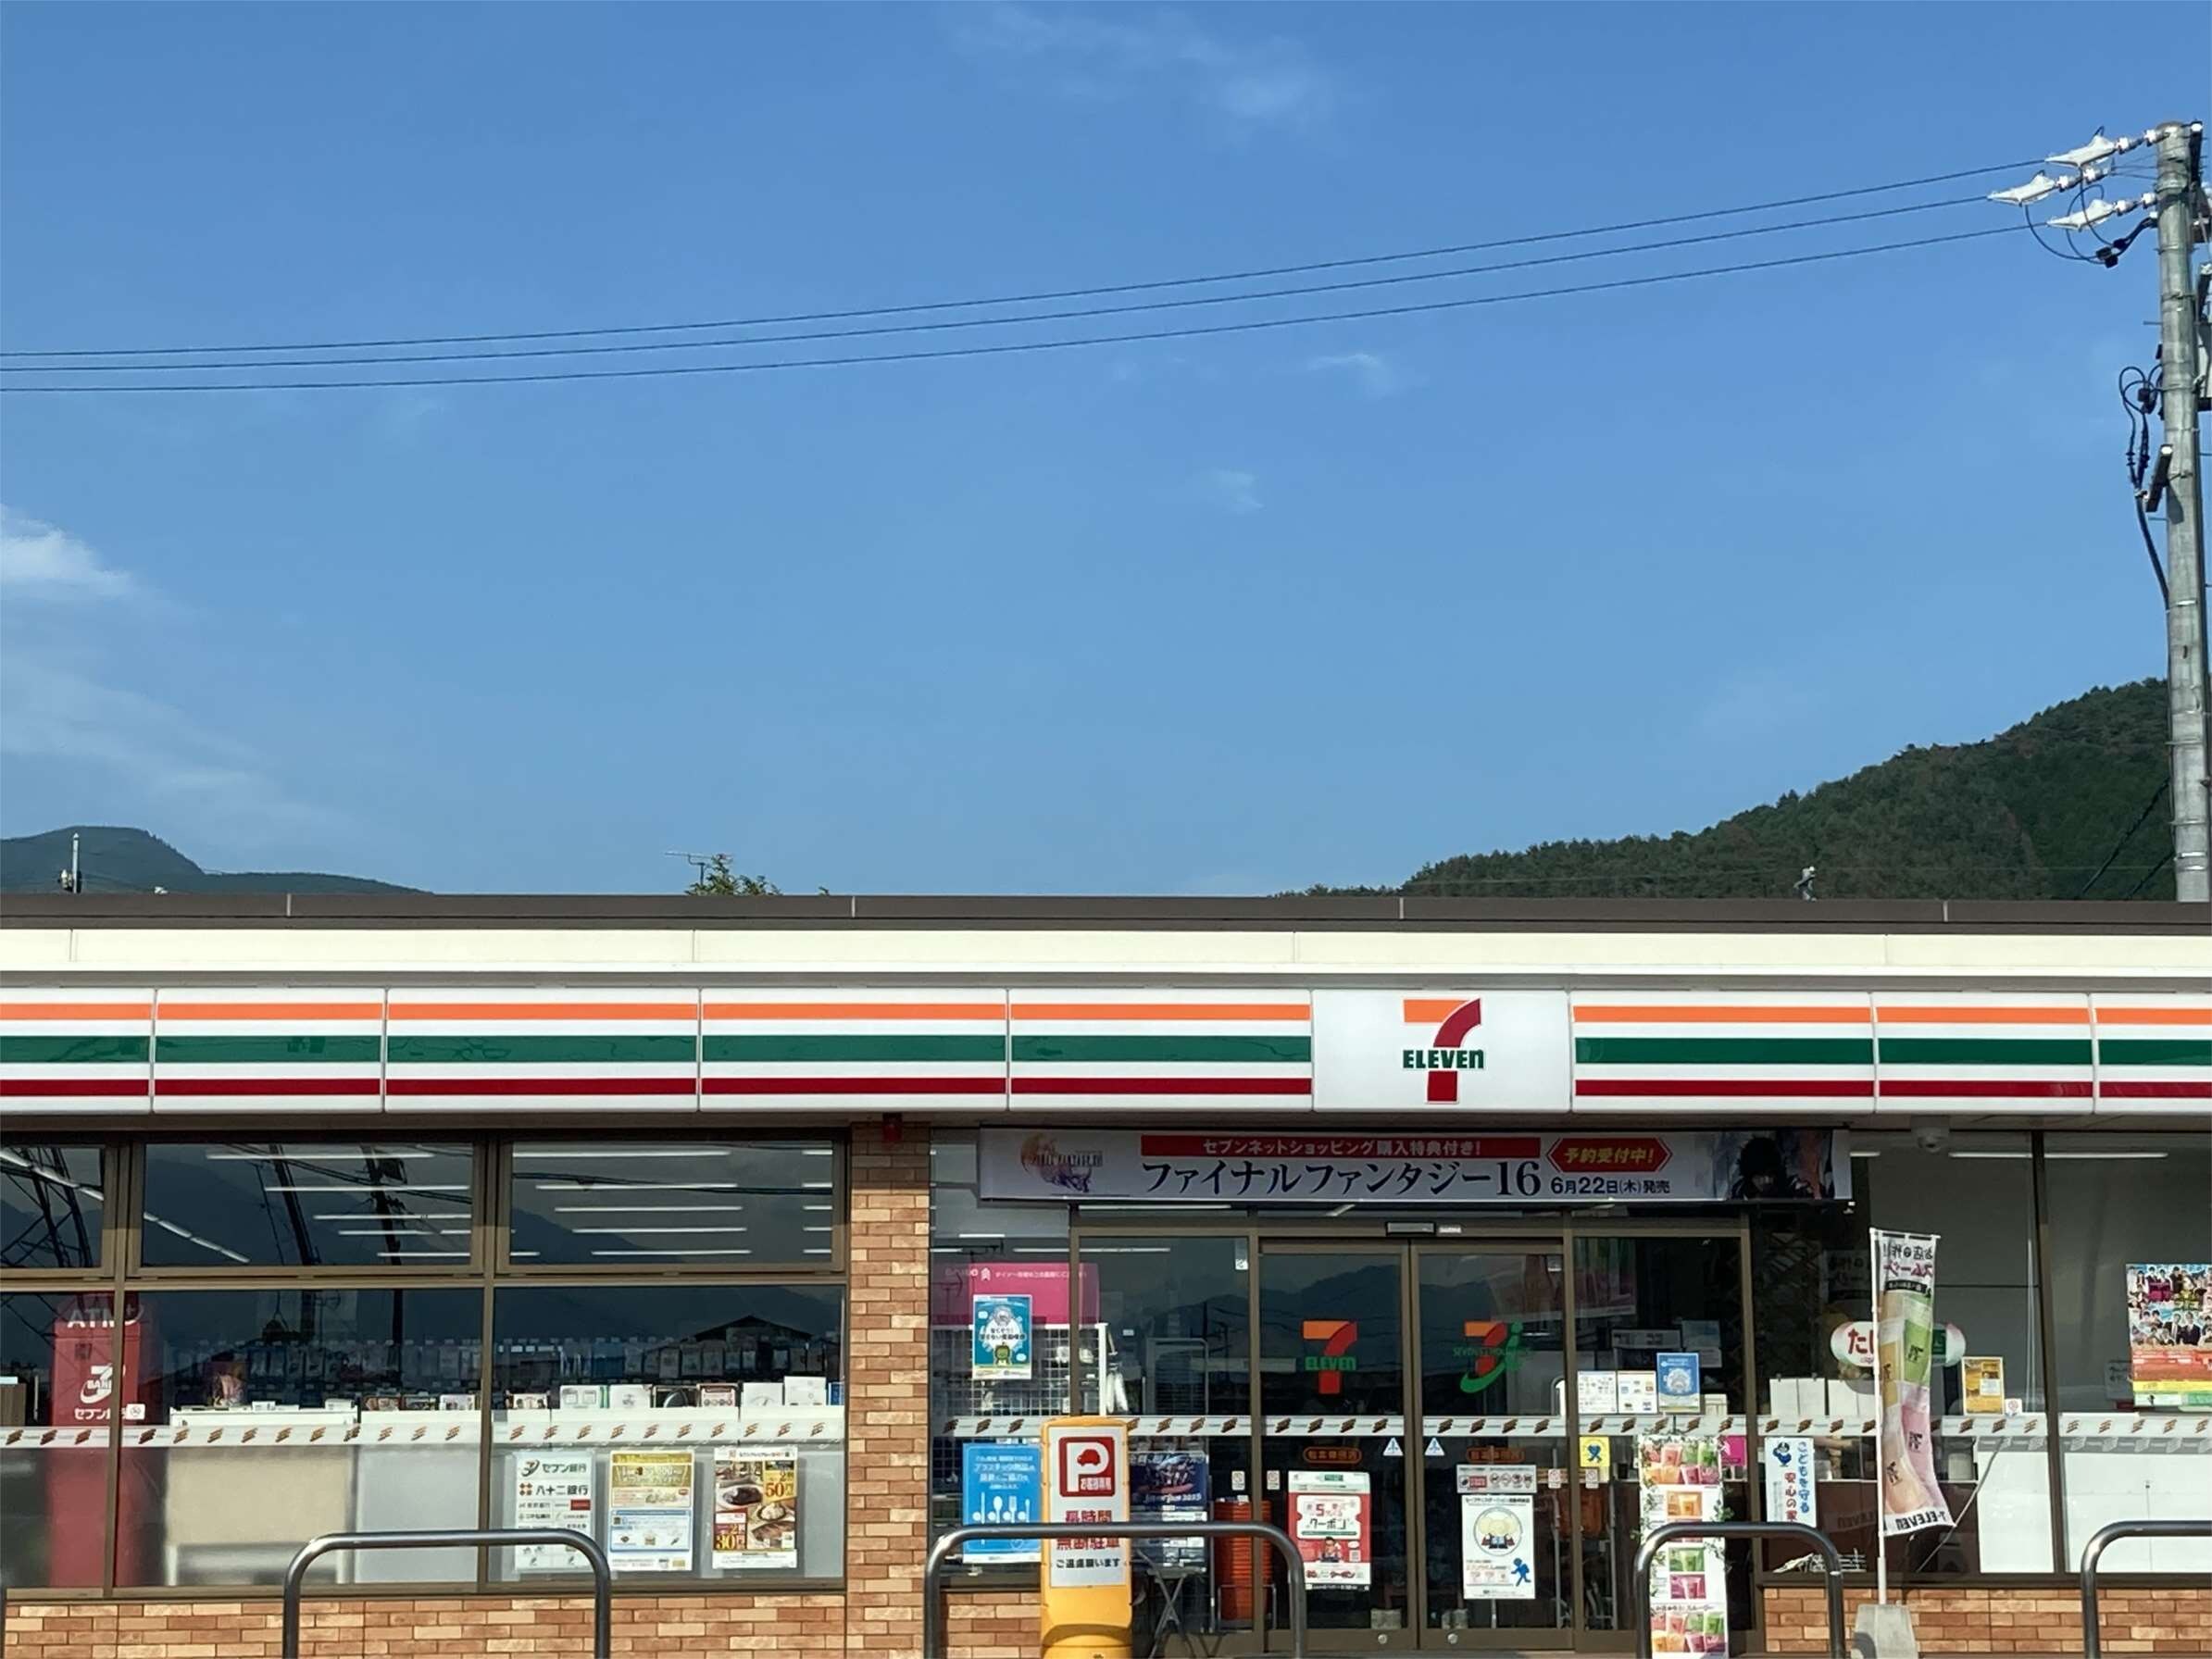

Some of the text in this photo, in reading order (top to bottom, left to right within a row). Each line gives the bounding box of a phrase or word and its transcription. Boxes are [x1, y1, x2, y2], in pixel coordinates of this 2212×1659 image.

[1564, 1147, 1655, 1165] 予約受付中!
[1143, 1159, 1542, 1197] ファイナルファンタジー16
[1550, 1177, 1670, 1195] 6月22日(木)発売
[542, 1463, 587, 1474] セブン銀行
[1067, 1442, 1109, 1492] P
[535, 1484, 589, 1496] 八十二銀行
